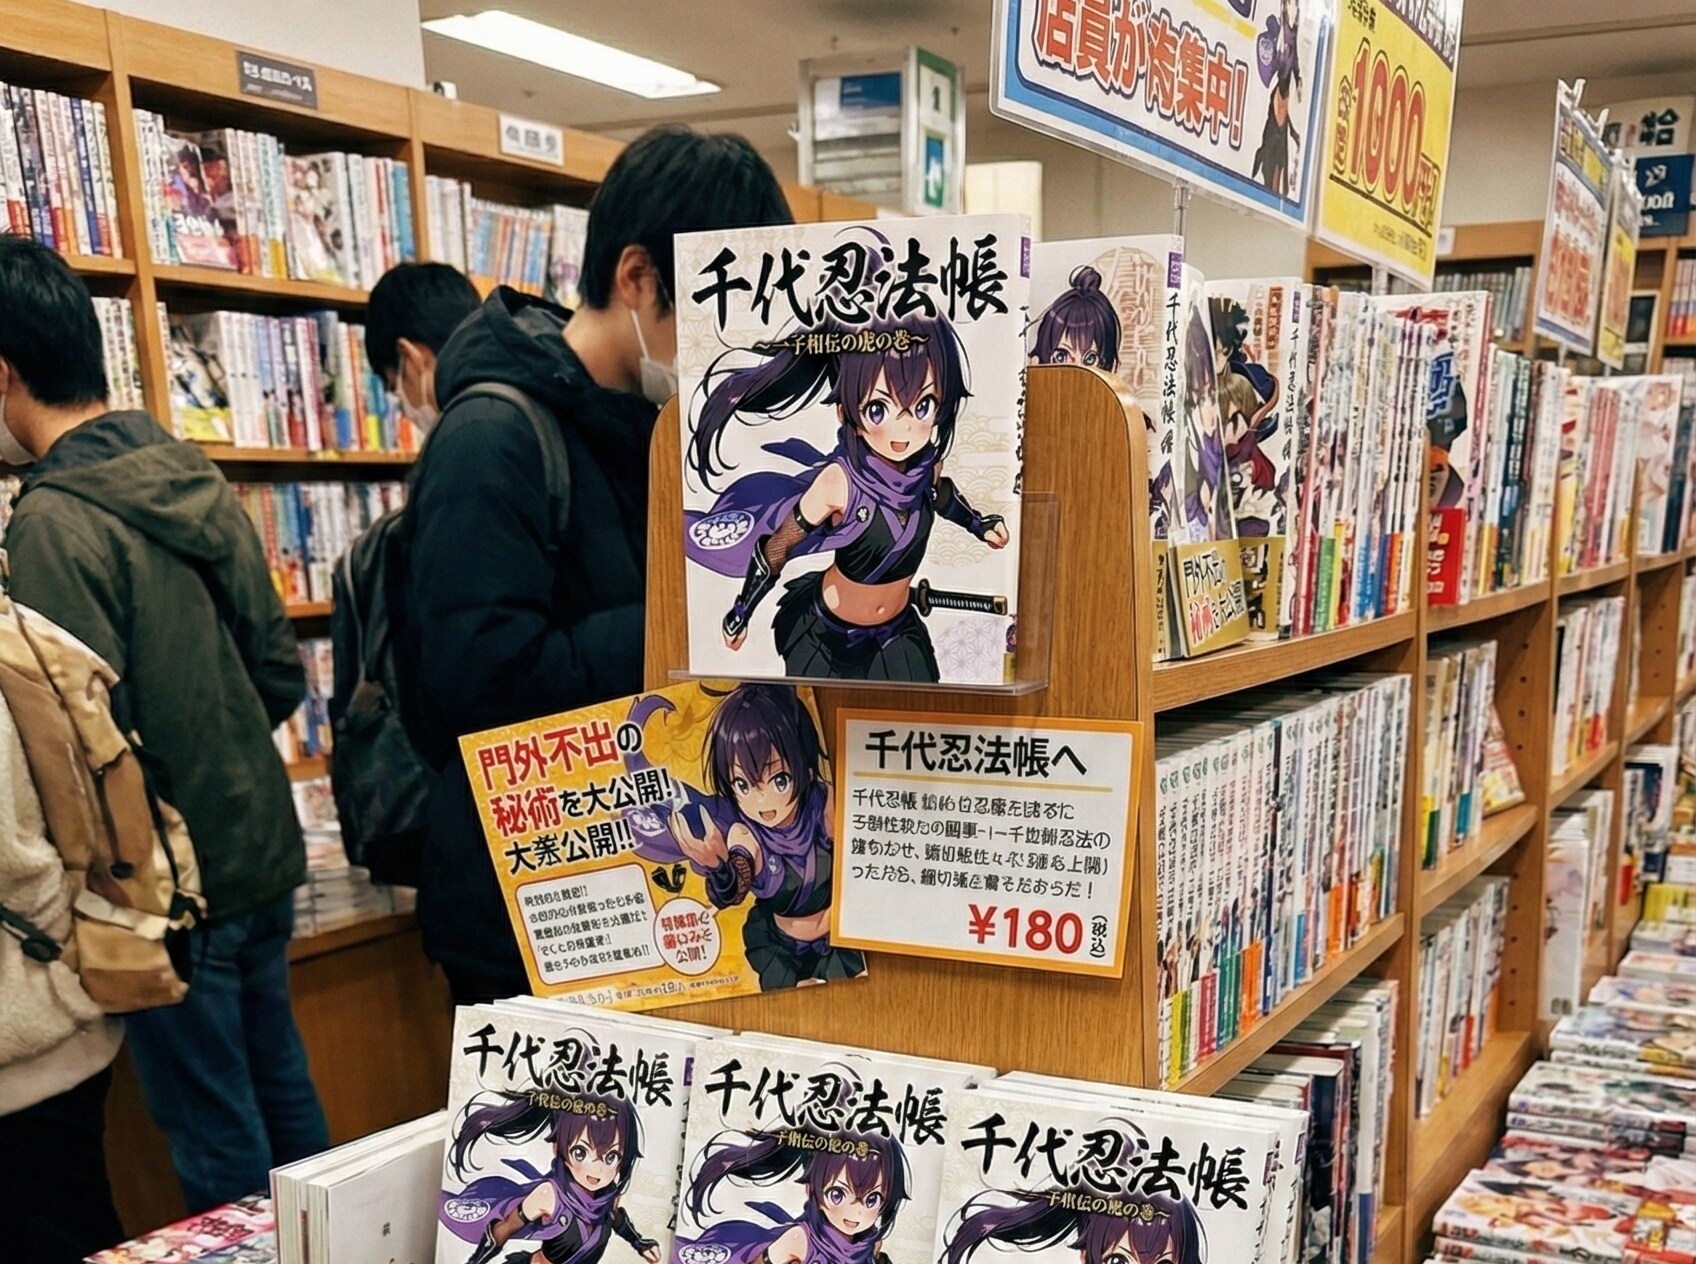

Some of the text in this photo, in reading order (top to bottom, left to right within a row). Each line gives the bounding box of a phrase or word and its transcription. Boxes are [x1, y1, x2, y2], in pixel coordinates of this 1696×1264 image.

[691, 233, 1009, 332] 千代忍法帳
[478, 720, 643, 791] 門外不出の
[865, 728, 1087, 778] 千代忍法帳へ
[490, 768, 673, 838] 秘術を大公開!
[968, 903, 1084, 955] ¥180
[463, 1023, 675, 1107] 千代忍法帳
[705, 1059, 948, 1145] 千代忍法帳
[961, 1113, 1251, 1211] 千代忍法帳
